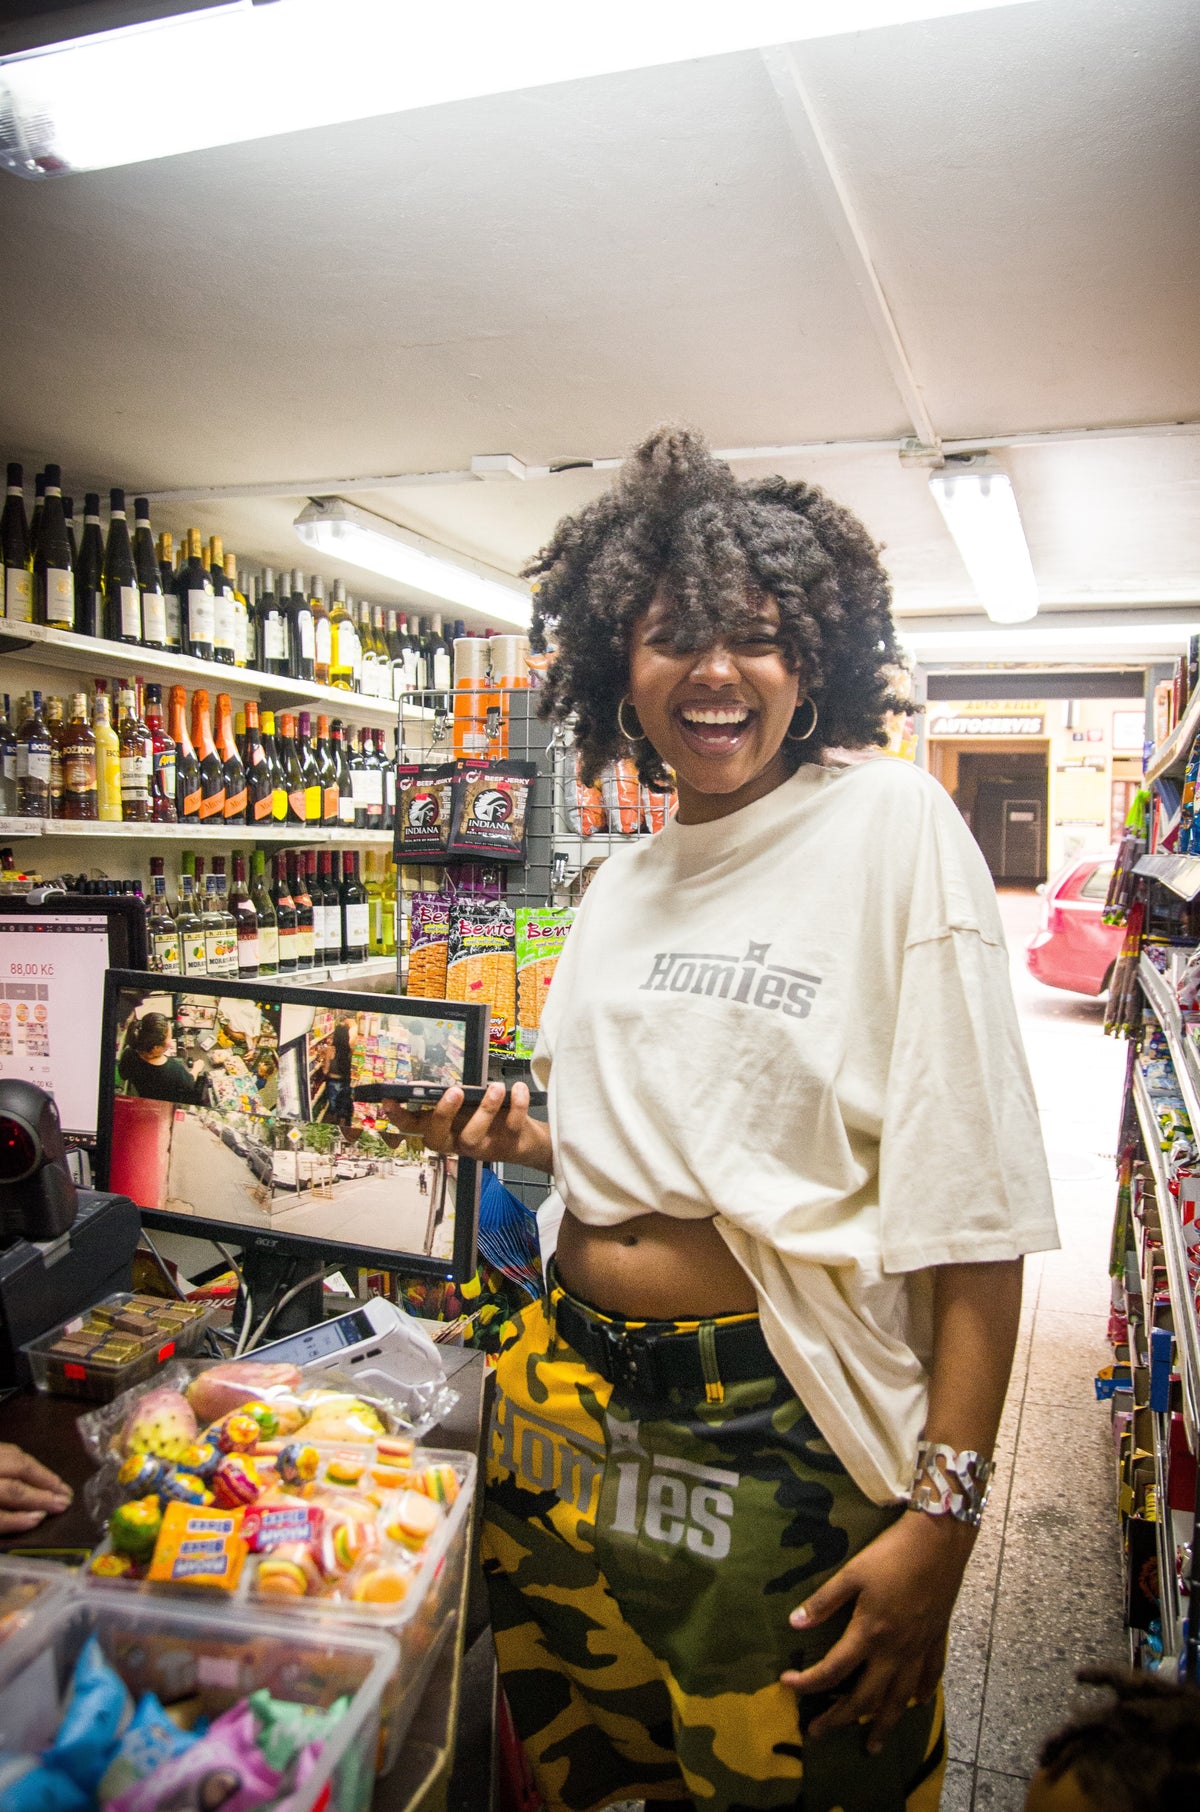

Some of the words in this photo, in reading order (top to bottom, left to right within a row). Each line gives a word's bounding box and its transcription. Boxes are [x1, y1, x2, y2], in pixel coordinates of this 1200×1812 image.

[933, 716, 1041, 734] AUTOSERVIS
[505, 777, 530, 785] JERKY
[405, 826, 439, 835] INDIANA
[468, 819, 510, 831] INDIANA
[458, 919, 515, 937] Bento
[10, 963, 39, 977] 88,00
[41, 963, 55, 976] Kč
[639, 939, 822, 1019] Homies
[255, 1236, 279, 1247] acer
